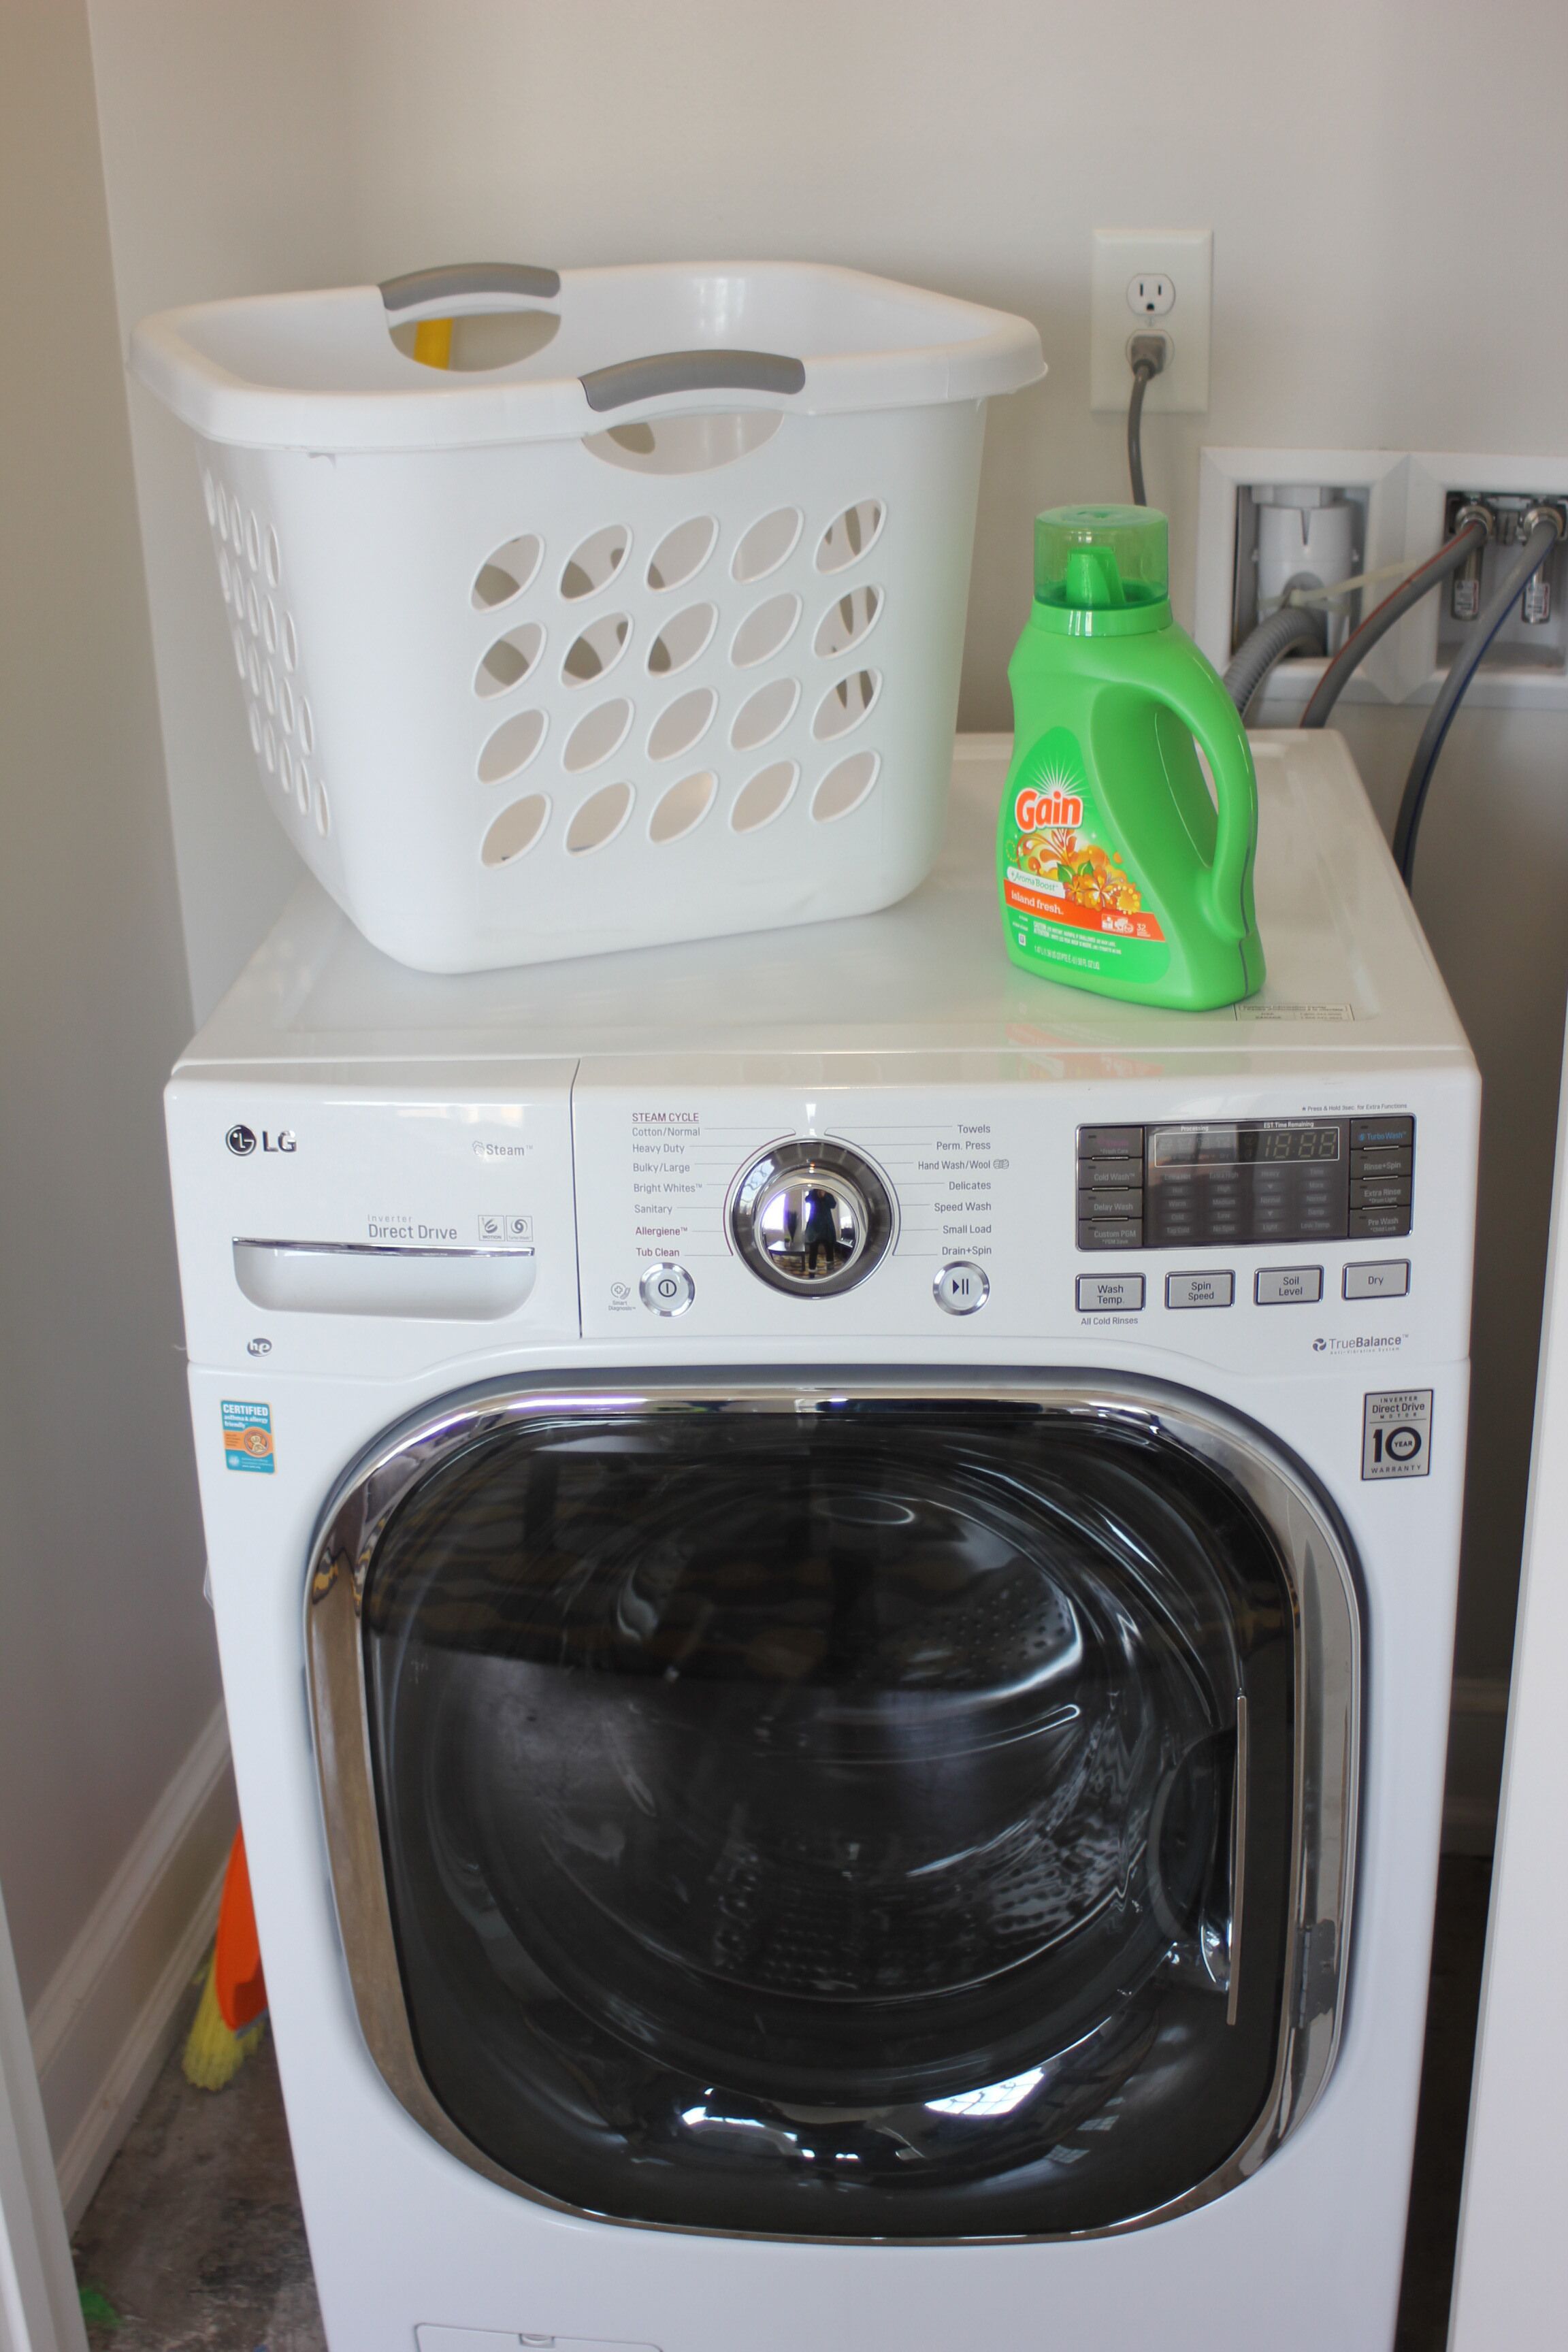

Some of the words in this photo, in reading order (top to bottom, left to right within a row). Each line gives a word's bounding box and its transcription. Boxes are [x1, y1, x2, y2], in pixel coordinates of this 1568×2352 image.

[1015, 789, 1082, 832] Gain
[632, 1113, 666, 1122] STEAM
[668, 1113, 699, 1122] CYCLE
[632, 1127, 700, 1137] Cotton/Normal
[958, 1124, 991, 1133] Towels
[263, 1130, 297, 1153] LG
[936, 1141, 962, 1150] Perm.
[965, 1141, 991, 1149] Press
[632, 1143, 661, 1154] Heavy
[664, 1143, 685, 1154] Duty
[633, 1162, 690, 1173] Bulky/Large
[918, 1160, 939, 1170] Hand
[941, 1160, 990, 1170] Wash/Wool
[1364, 1162, 1401, 1171] Rinse+Spin
[634, 1183, 662, 1194] Bright
[949, 1181, 991, 1190] Delicates
[634, 1204, 672, 1215] Sanitary
[934, 1203, 963, 1213] Speed
[966, 1202, 991, 1211] Wash
[1094, 1203, 1113, 1211] Delay
[368, 1214, 412, 1222] Inverter
[1379, 1217, 1399, 1225] Wash
[368, 1224, 414, 1239] Direct
[418, 1225, 457, 1239] Drive
[943, 1225, 967, 1234] Small
[970, 1225, 992, 1233] Load
[1094, 1230, 1120, 1238] Custom
[636, 1247, 653, 1256] Tub
[655, 1247, 680, 1256] Clean
[942, 1246, 992, 1256] Drain+Spin
[1284, 1277, 1299, 1285] Soil
[1368, 1276, 1384, 1286] Dry
[1098, 1285, 1124, 1293] Wash
[1191, 1282, 1211, 1292] Spin
[1279, 1287, 1303, 1296] Level
[1188, 1292, 1214, 1301] Speed
[1093, 1317, 1110, 1325] Cold
[223, 1404, 268, 1416] CERTIFIED
[1372, 1405, 1399, 1414] Direct
[1401, 1403, 1425, 1412] Drive
[1373, 1426, 1422, 1463] 10
[1371, 1465, 1422, 1473] WARRANTY
